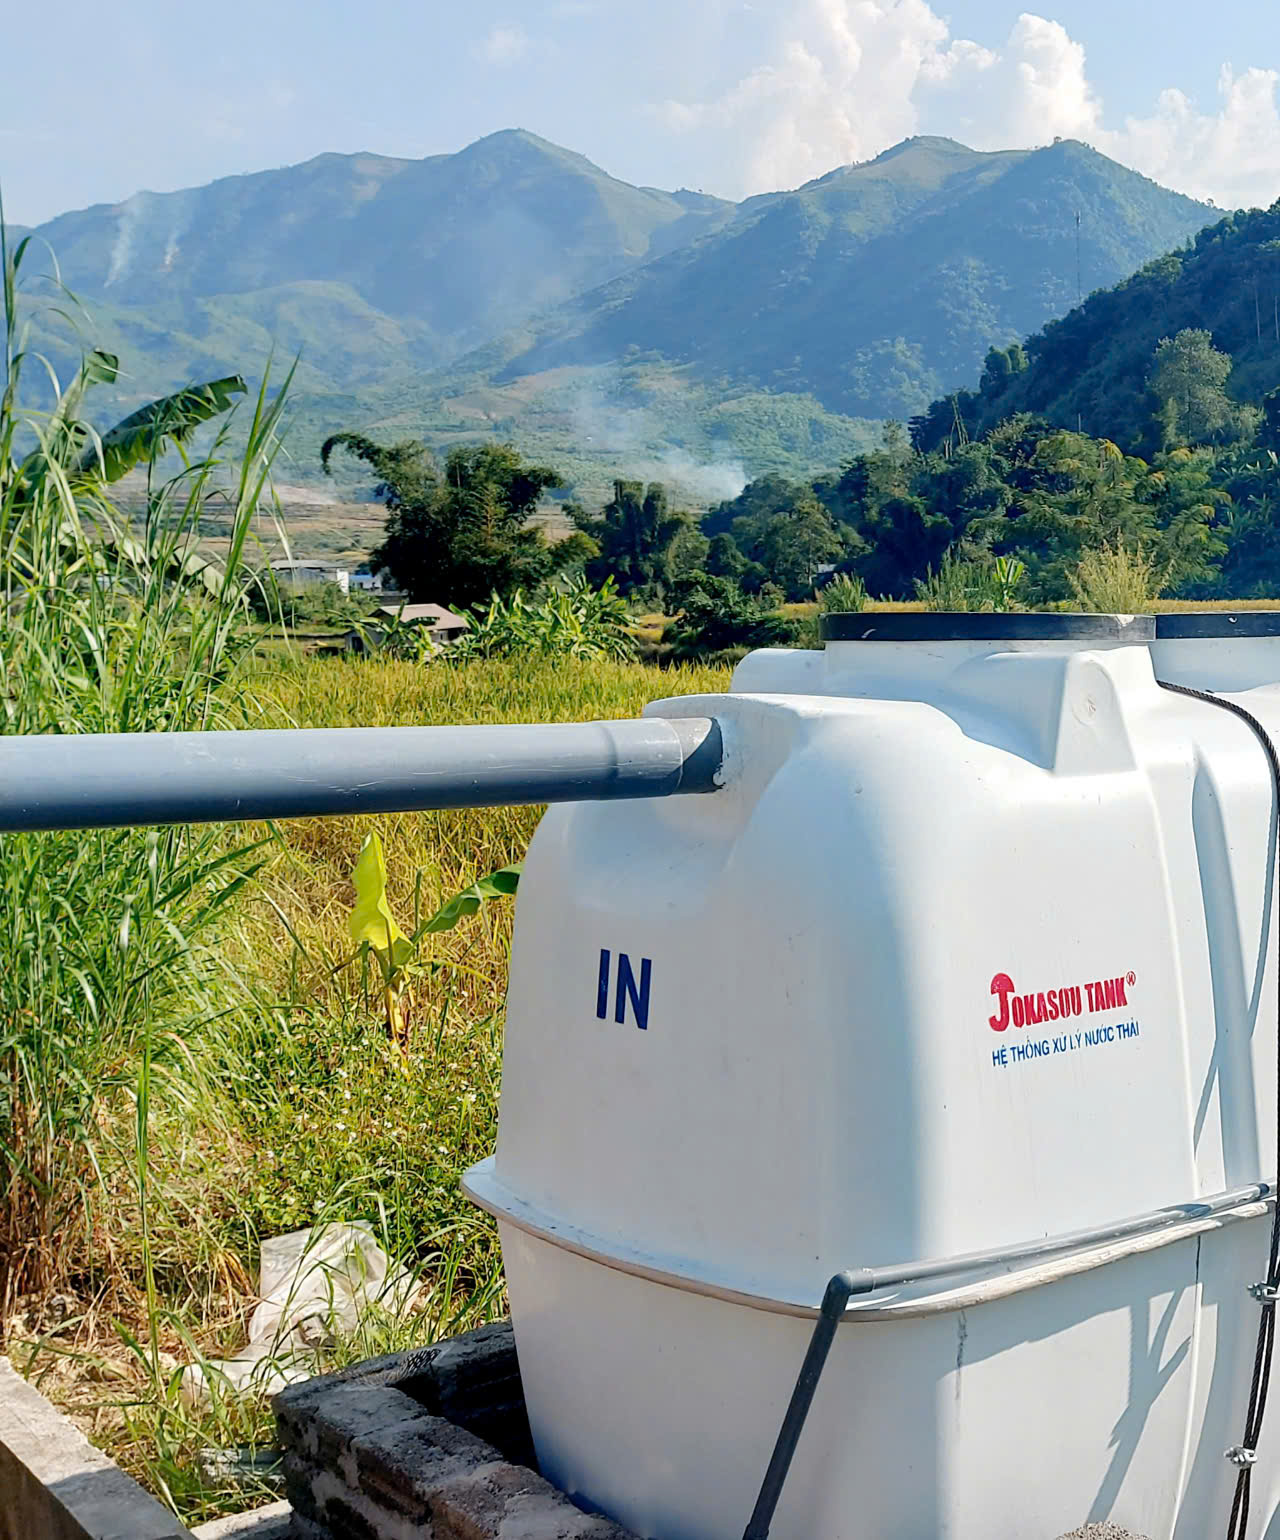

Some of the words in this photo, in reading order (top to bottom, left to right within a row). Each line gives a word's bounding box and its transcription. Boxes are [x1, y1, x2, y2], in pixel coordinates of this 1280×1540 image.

[596, 948, 652, 1030] IN
[992, 1044, 1008, 1068] HỆ
[1069, 1028, 1082, 1051] LÝ
[1085, 1023, 1115, 1047] NƯỚC
[1116, 1017, 1140, 1041] THẢI
